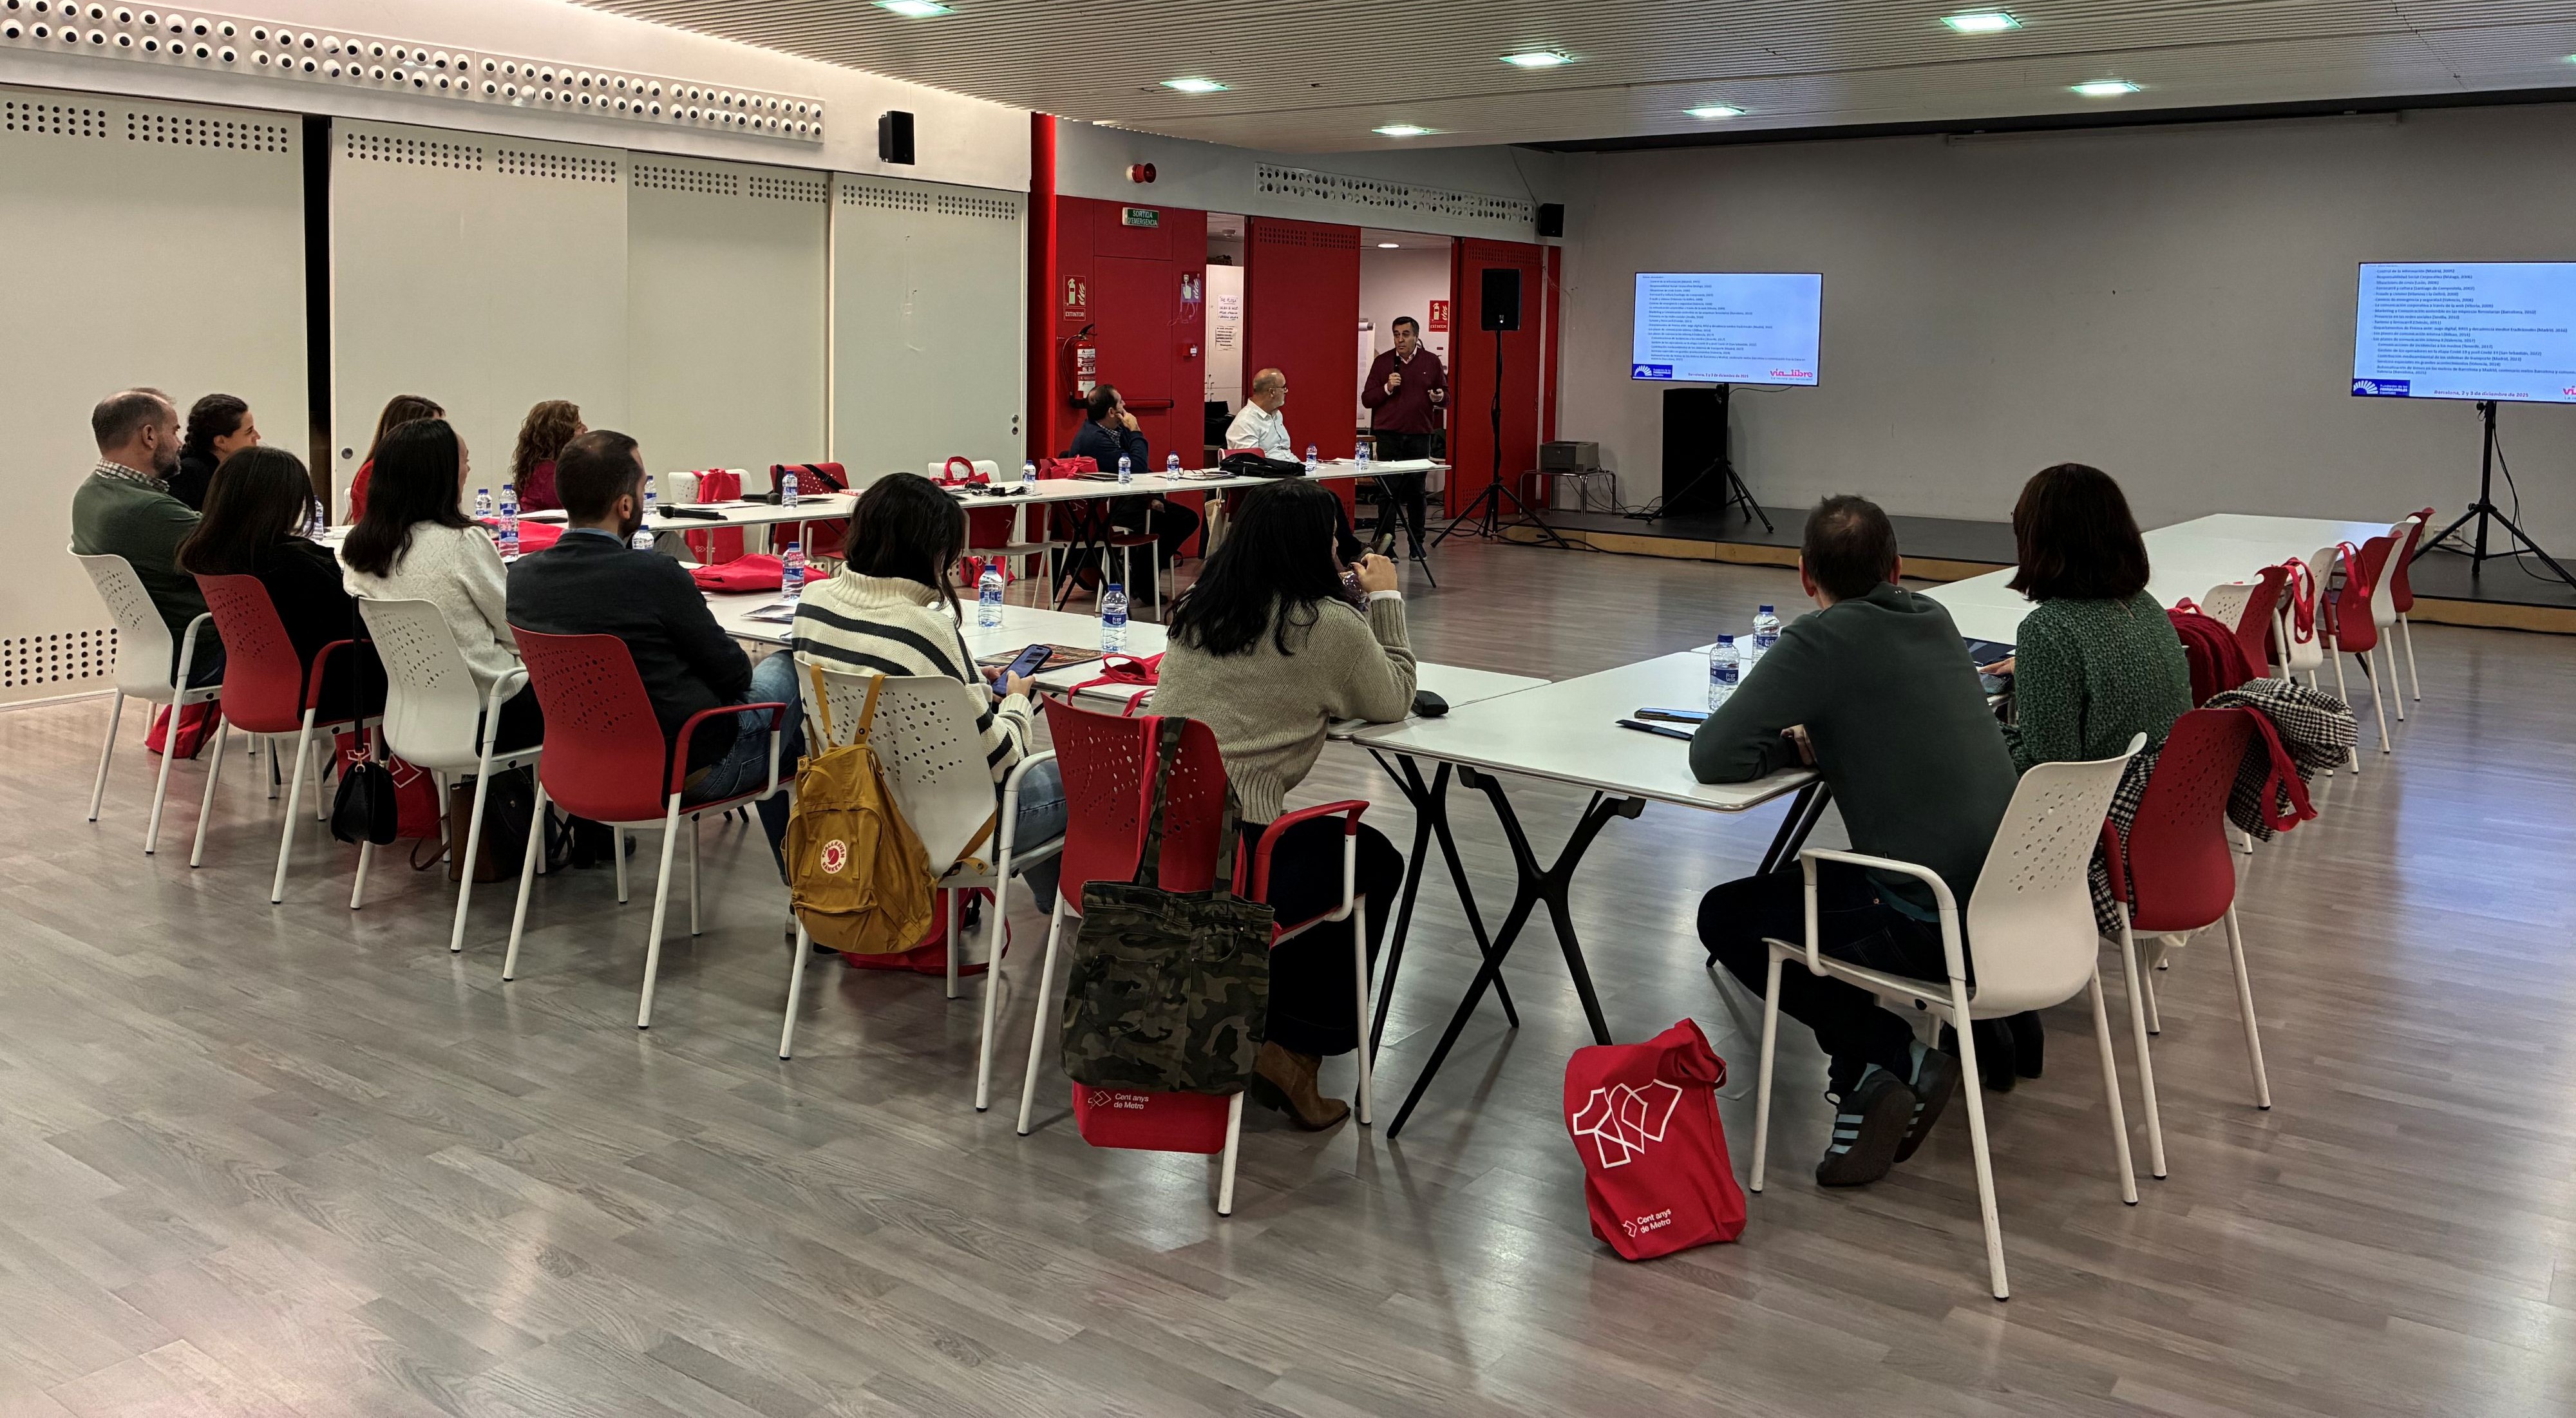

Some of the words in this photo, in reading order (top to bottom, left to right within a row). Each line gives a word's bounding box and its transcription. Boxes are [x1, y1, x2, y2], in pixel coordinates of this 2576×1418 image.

[1133, 210, 1153, 218] SORTIDA
[1637, 1214, 1654, 1224] Cent
[1656, 1209, 1671, 1220] anys
[1640, 1225, 1649, 1234] de
[1650, 1218, 1671, 1229] Metro
